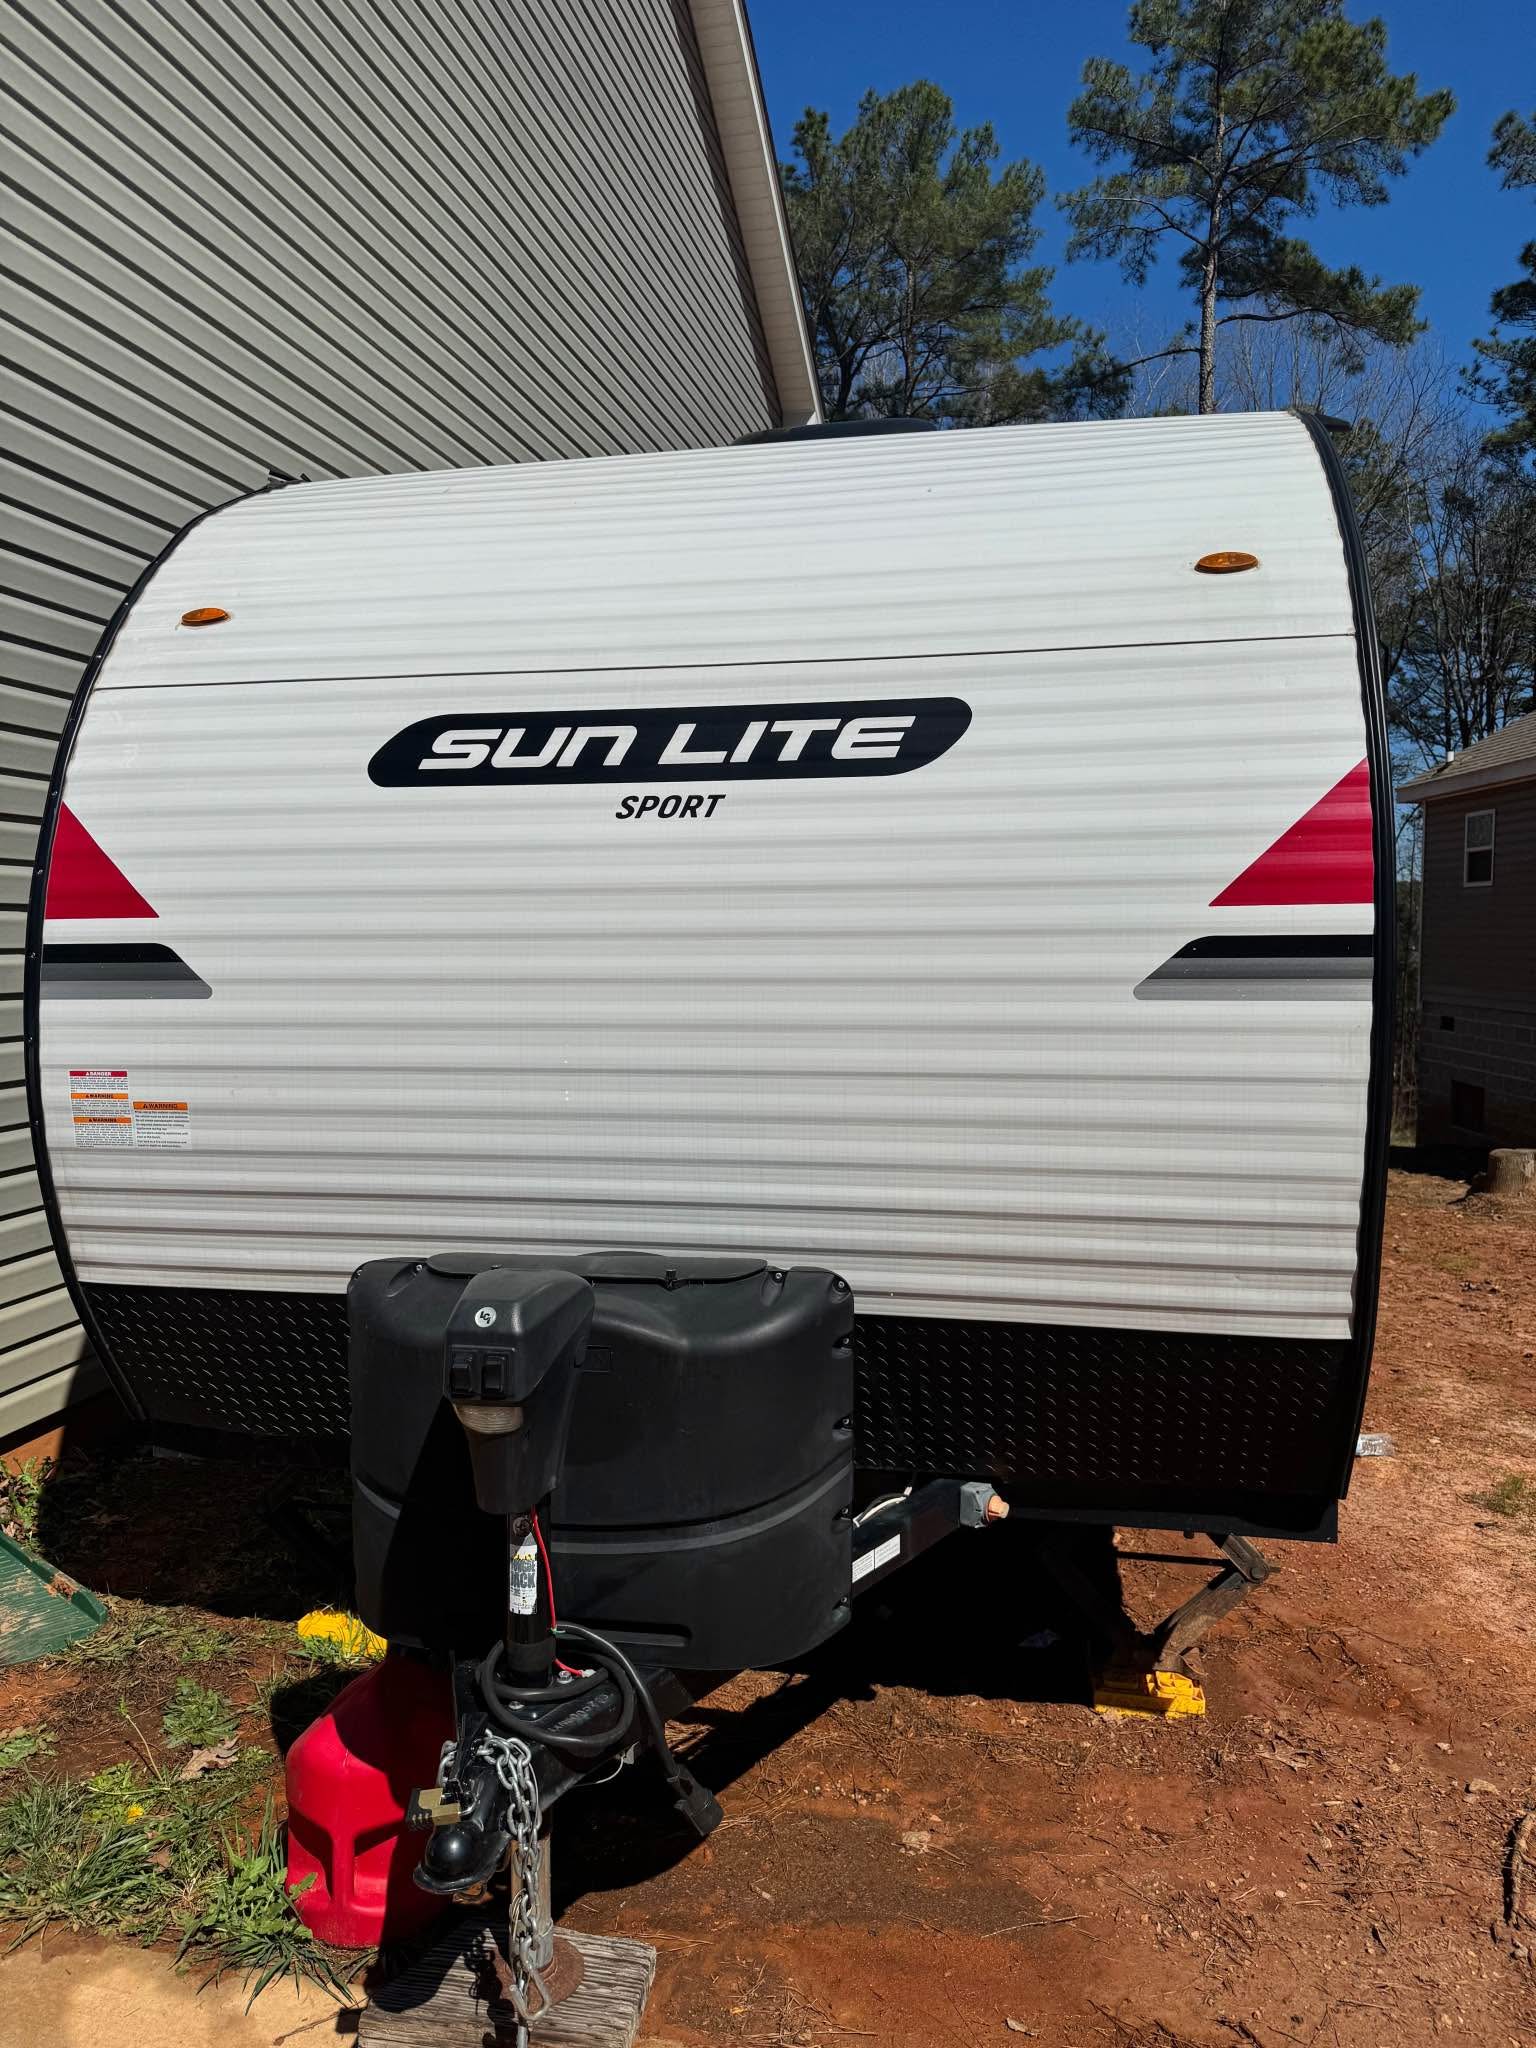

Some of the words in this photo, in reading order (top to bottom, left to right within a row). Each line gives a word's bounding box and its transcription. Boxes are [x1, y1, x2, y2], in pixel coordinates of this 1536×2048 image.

[418, 725, 638, 770] SUN
[657, 715, 917, 765] LITE
[615, 794, 726, 820] SPORT
